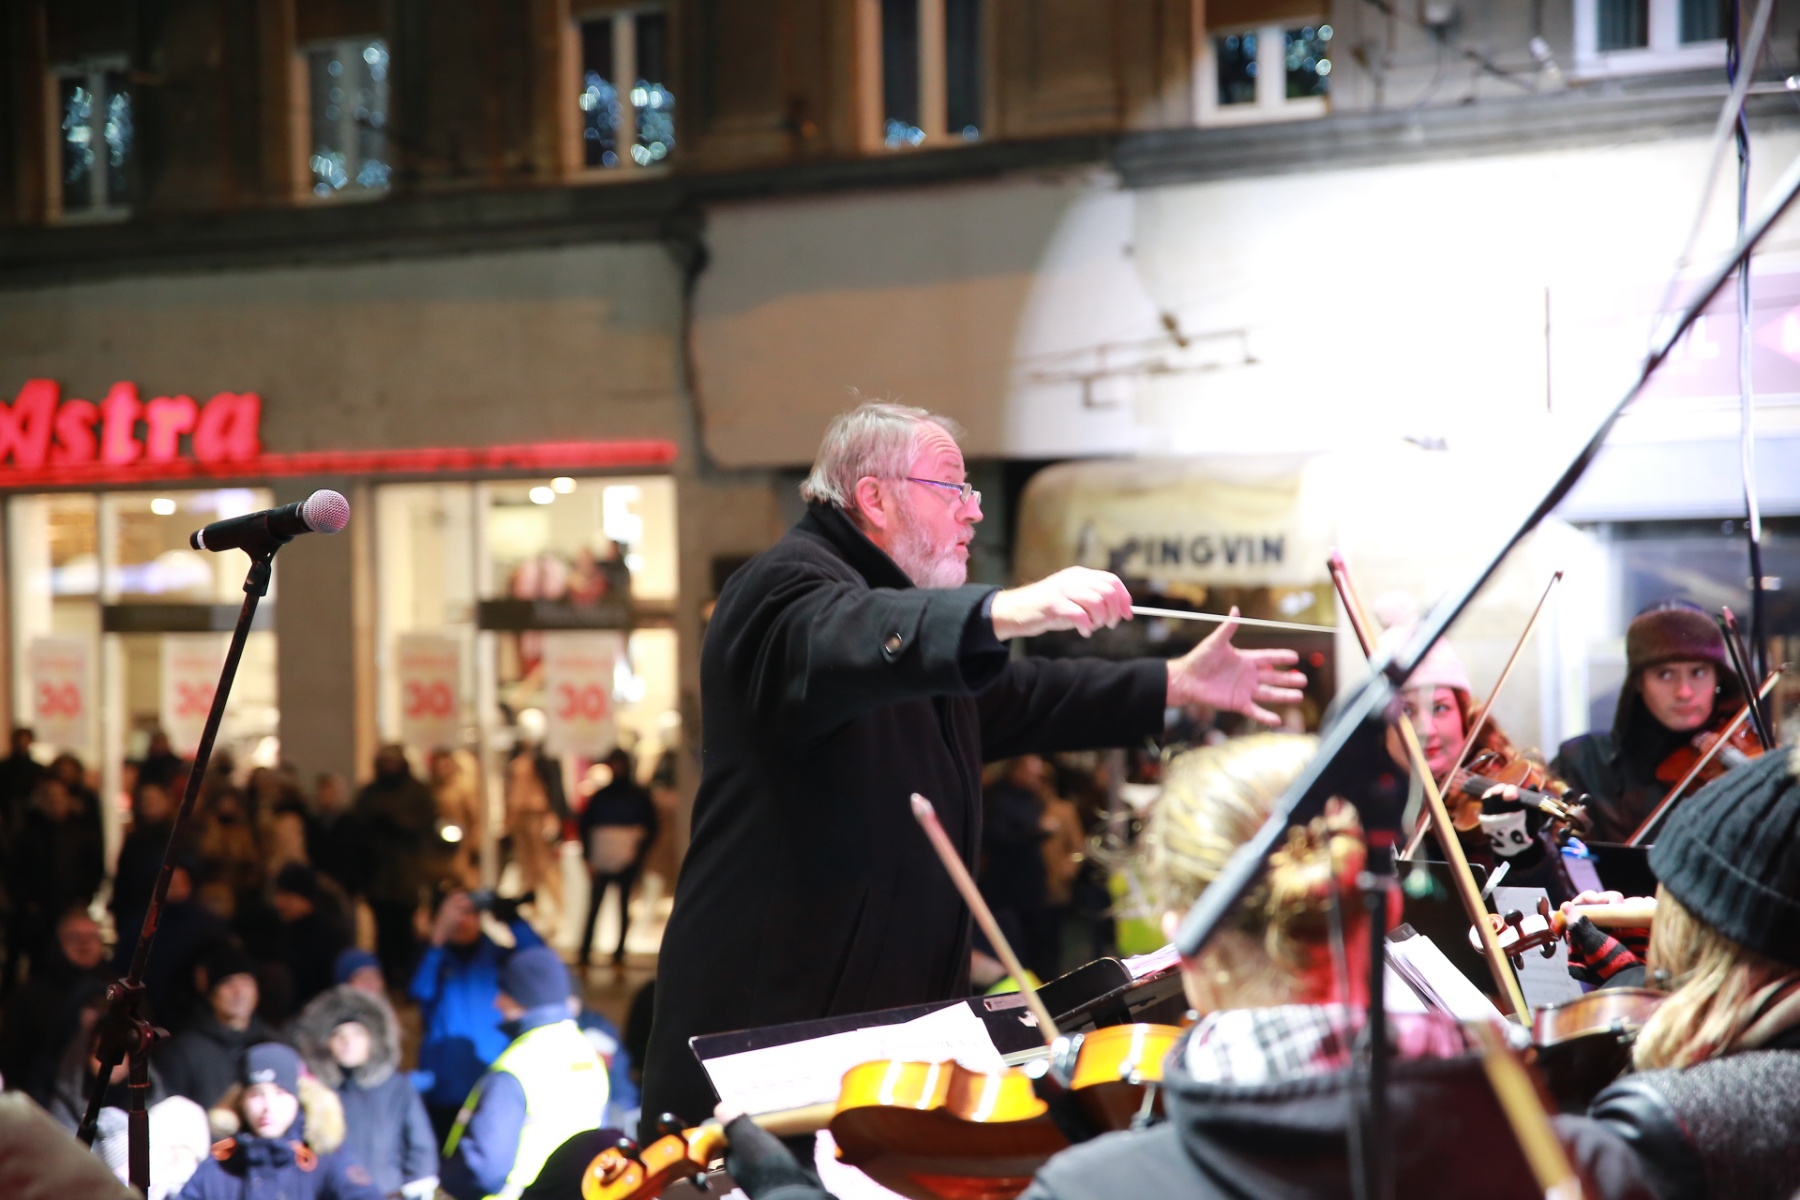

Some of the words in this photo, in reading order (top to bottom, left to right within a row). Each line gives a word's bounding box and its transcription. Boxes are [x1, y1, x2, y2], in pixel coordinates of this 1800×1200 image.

[0, 378, 261, 466] Astra
[1122, 533, 1286, 565] PINGVIN
[557, 683, 609, 722] 30
